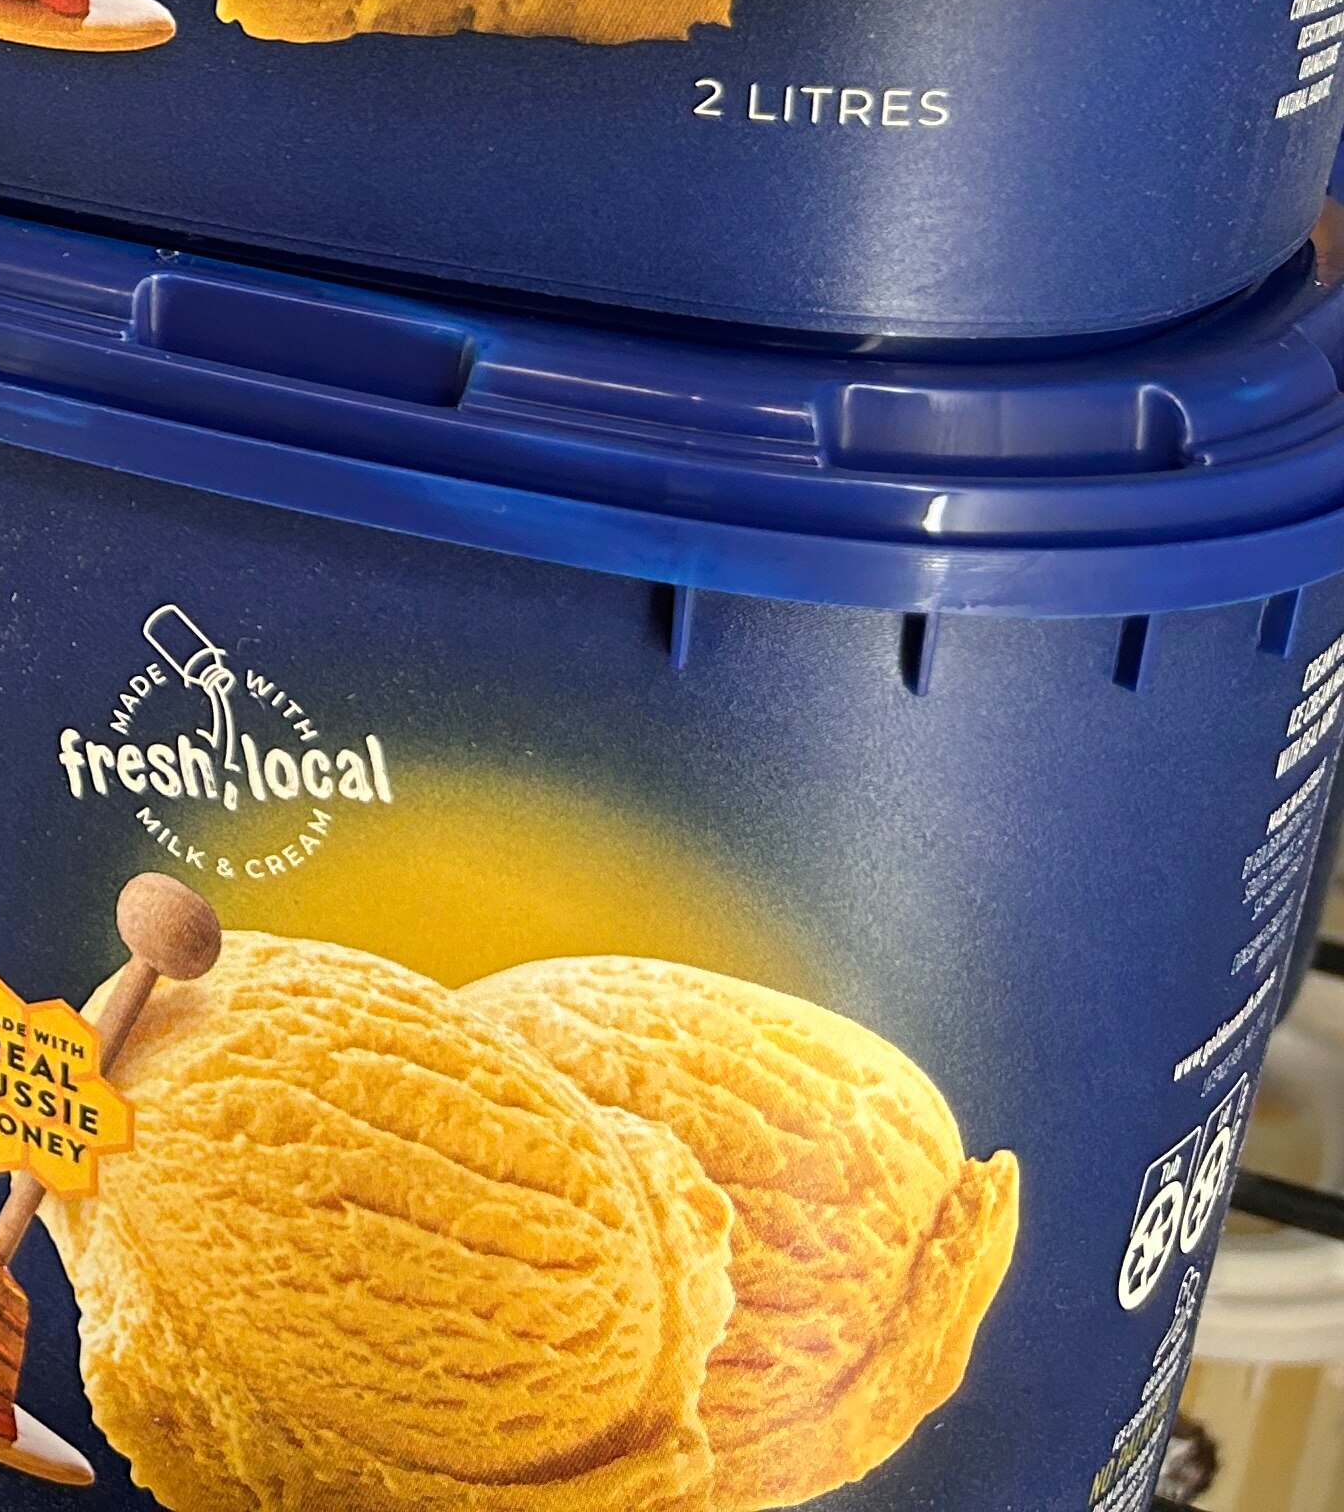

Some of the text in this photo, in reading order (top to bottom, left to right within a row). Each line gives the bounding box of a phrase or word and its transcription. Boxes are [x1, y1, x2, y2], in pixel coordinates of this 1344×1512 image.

[692, 79, 950, 126] 2 LITRES
[109, 662, 320, 741] MADE WITH
[59, 728, 393, 804] fresh local
[135, 807, 332, 880] MILK & CREAM
[32, 1025, 86, 1060] WITH
